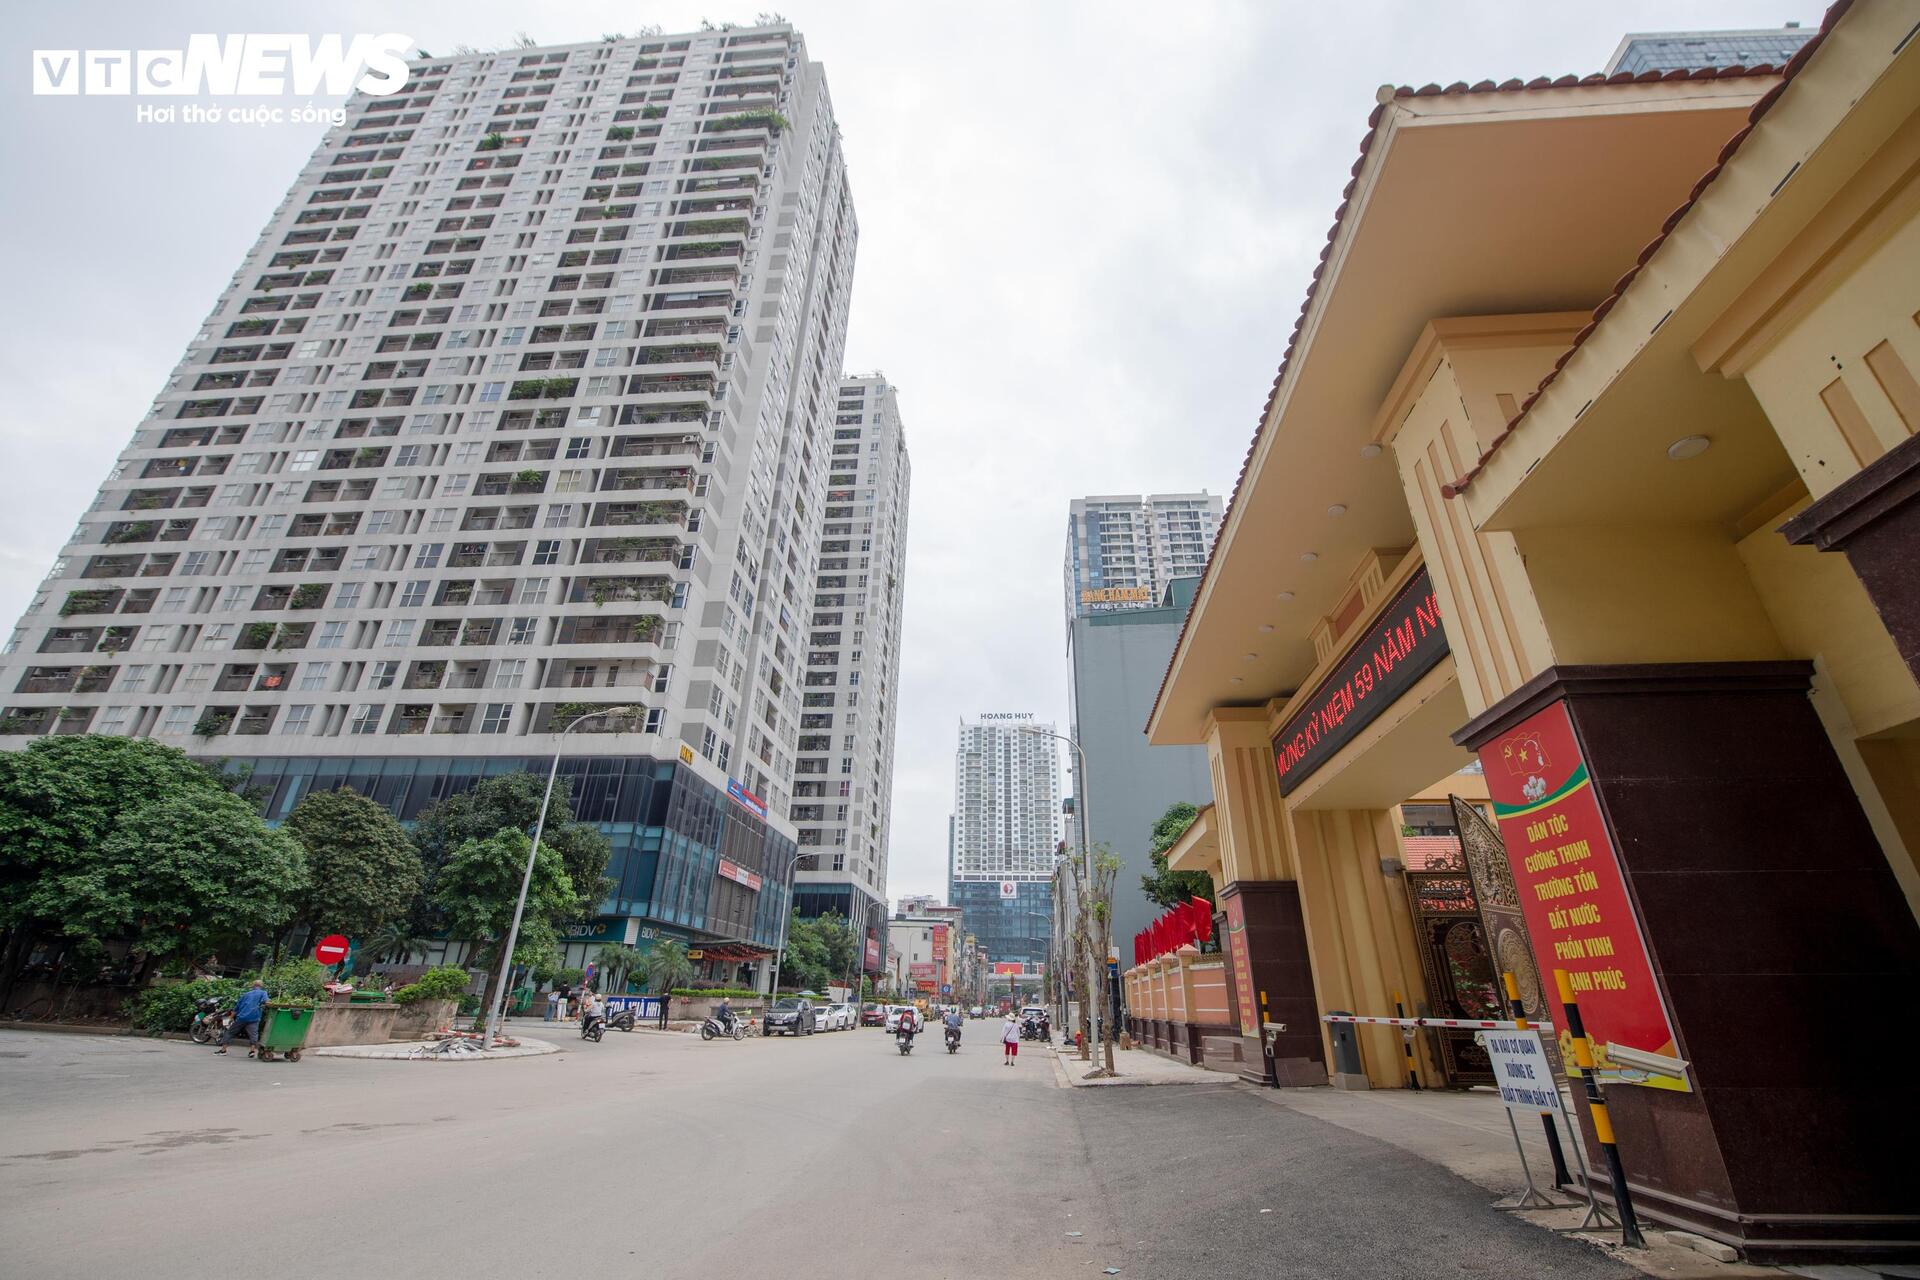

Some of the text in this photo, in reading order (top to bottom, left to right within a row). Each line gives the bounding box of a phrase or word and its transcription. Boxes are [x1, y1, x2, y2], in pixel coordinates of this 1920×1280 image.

[1321, 680, 1355, 735] NIỆM
[1354, 663, 1374, 701] 59
[1373, 616, 1417, 681] NĂM
[1014, 712, 1034, 720] HUY
[1526, 813, 1569, 843] DÂN TỘC
[1524, 839, 1591, 873] CƯỜNG THỊNH
[1534, 867, 1599, 901] TRƯỜNG TỒN
[1548, 902, 1601, 930] ĐẤT NƯỚC
[569, 924, 597, 938] BIDV
[1584, 935, 1615, 958] VINH
[1591, 965, 1627, 991] PHÚC
[1490, 1039, 1501, 1054] RA
[1498, 1036, 1511, 1054] VÀO
[1518, 1039, 1537, 1056] QUAN
[1504, 1058, 1536, 1080] XUỐNG XE
[1500, 1083, 1517, 1103] XUẤT
[1532, 1085, 1549, 1107] GIẤY
